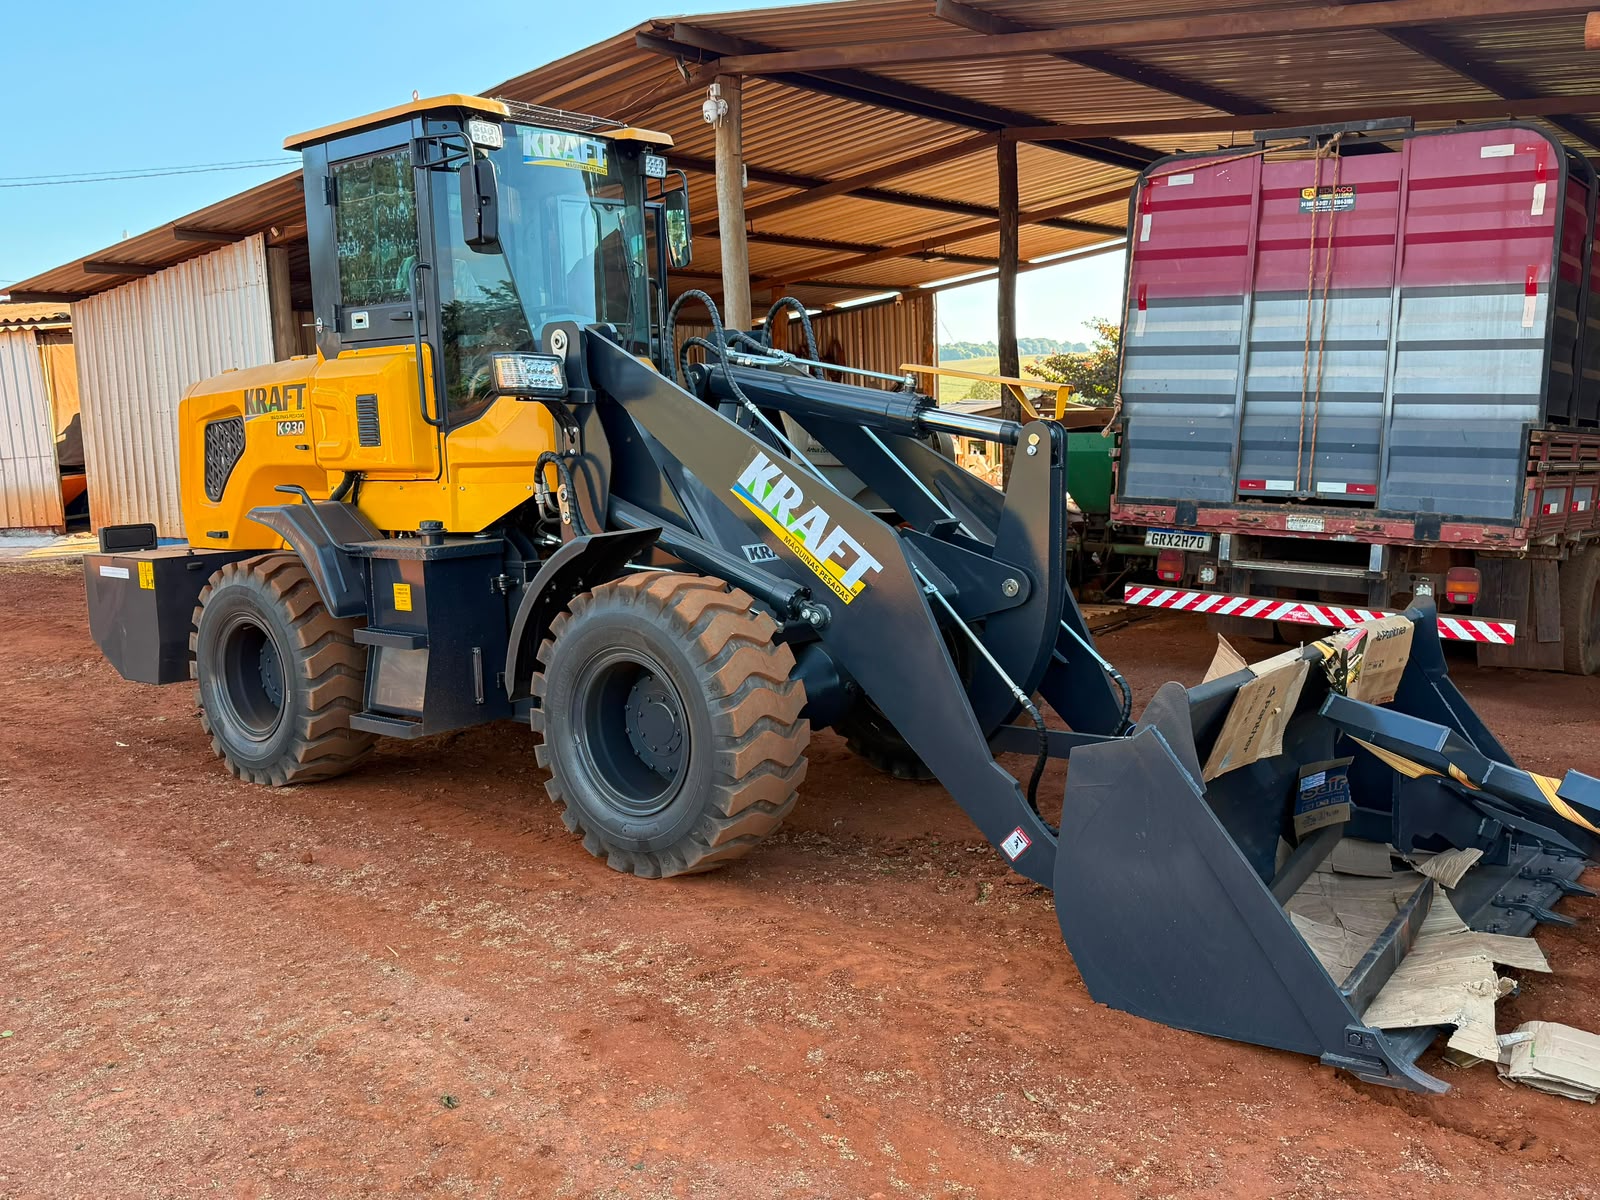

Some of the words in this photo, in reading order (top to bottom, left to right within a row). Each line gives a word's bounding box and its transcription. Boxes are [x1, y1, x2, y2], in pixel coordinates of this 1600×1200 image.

[523, 130, 606, 167] KRAFT
[244, 383, 306, 415] KRAFT
[277, 421, 304, 436] K930
[737, 451, 884, 589] KRAFT
[1151, 533, 1205, 549] GRX2H70
[783, 535, 818, 573] MÁQUINAS
[819, 570, 849, 602] PESADAS
